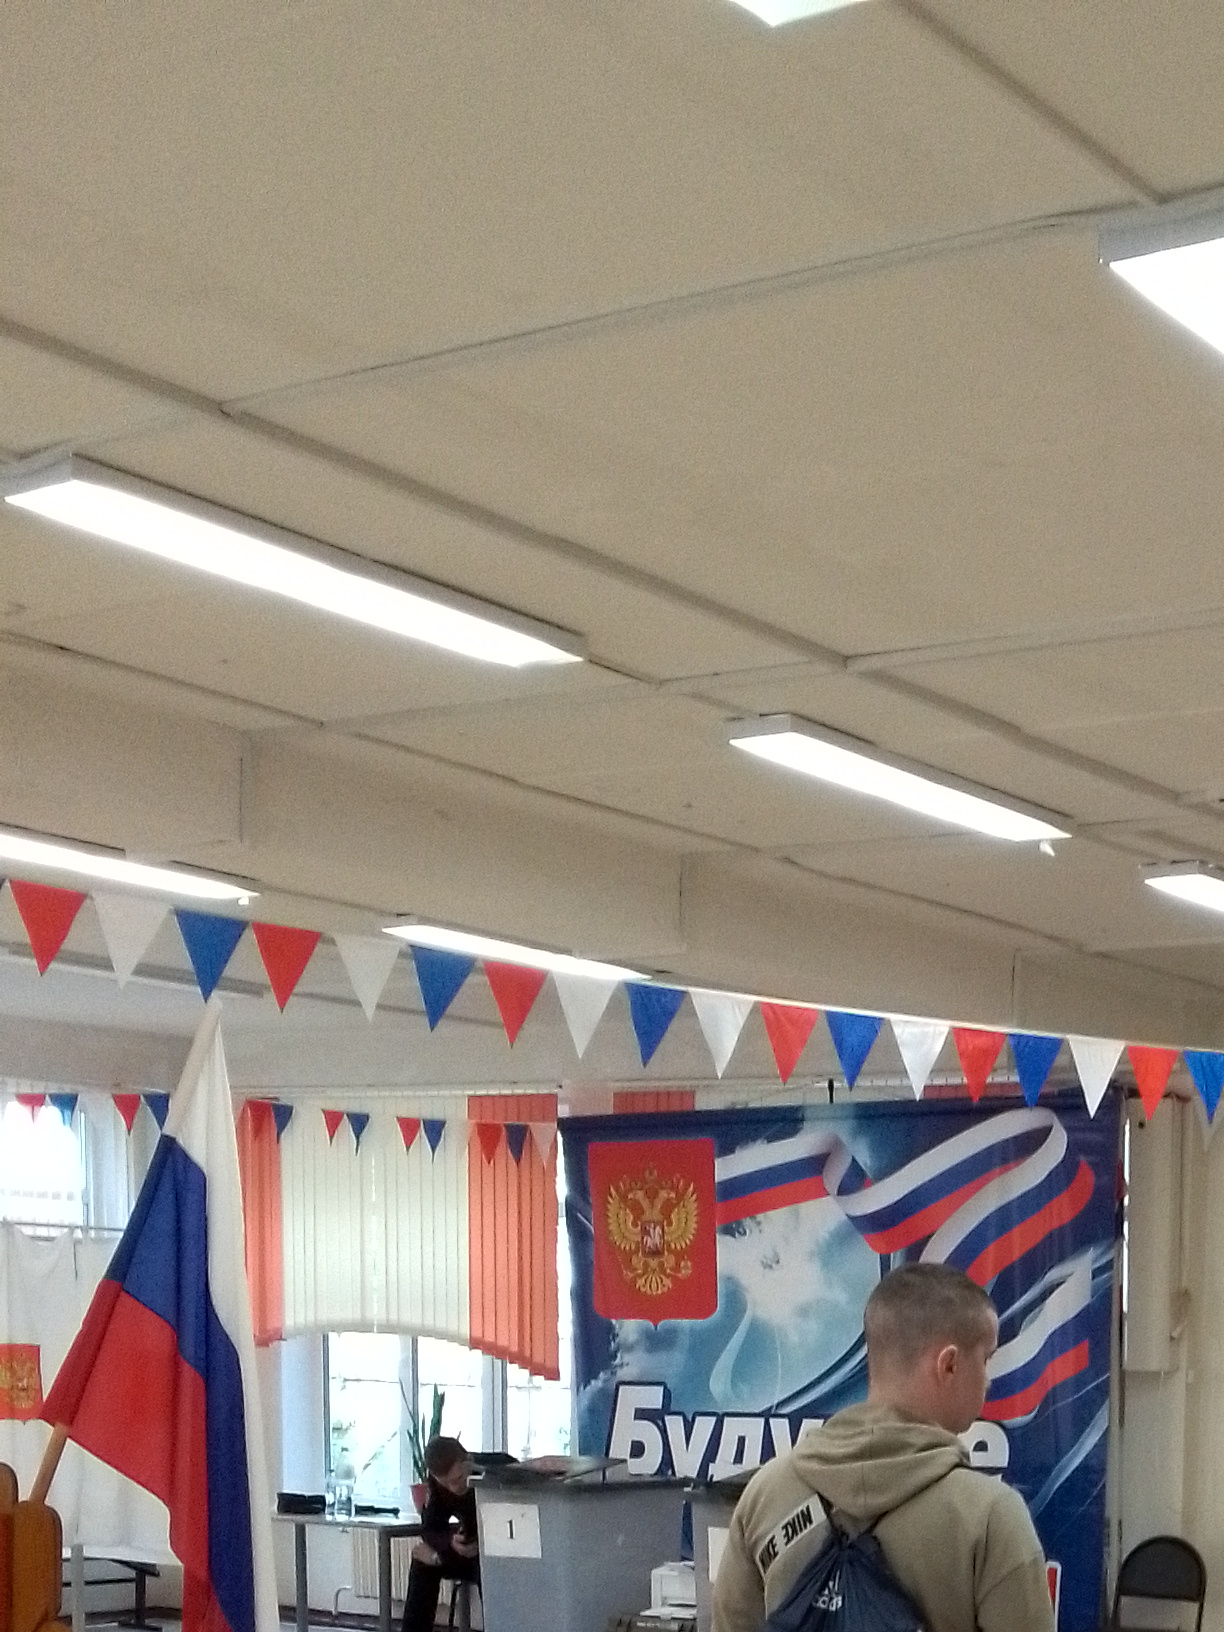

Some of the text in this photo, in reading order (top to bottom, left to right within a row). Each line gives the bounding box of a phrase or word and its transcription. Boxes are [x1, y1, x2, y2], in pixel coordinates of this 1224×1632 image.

[609, 1385, 1009, 1483] Будуе
[507, 1519, 514, 1539] 1
[781, 1504, 814, 1547] NIKE
